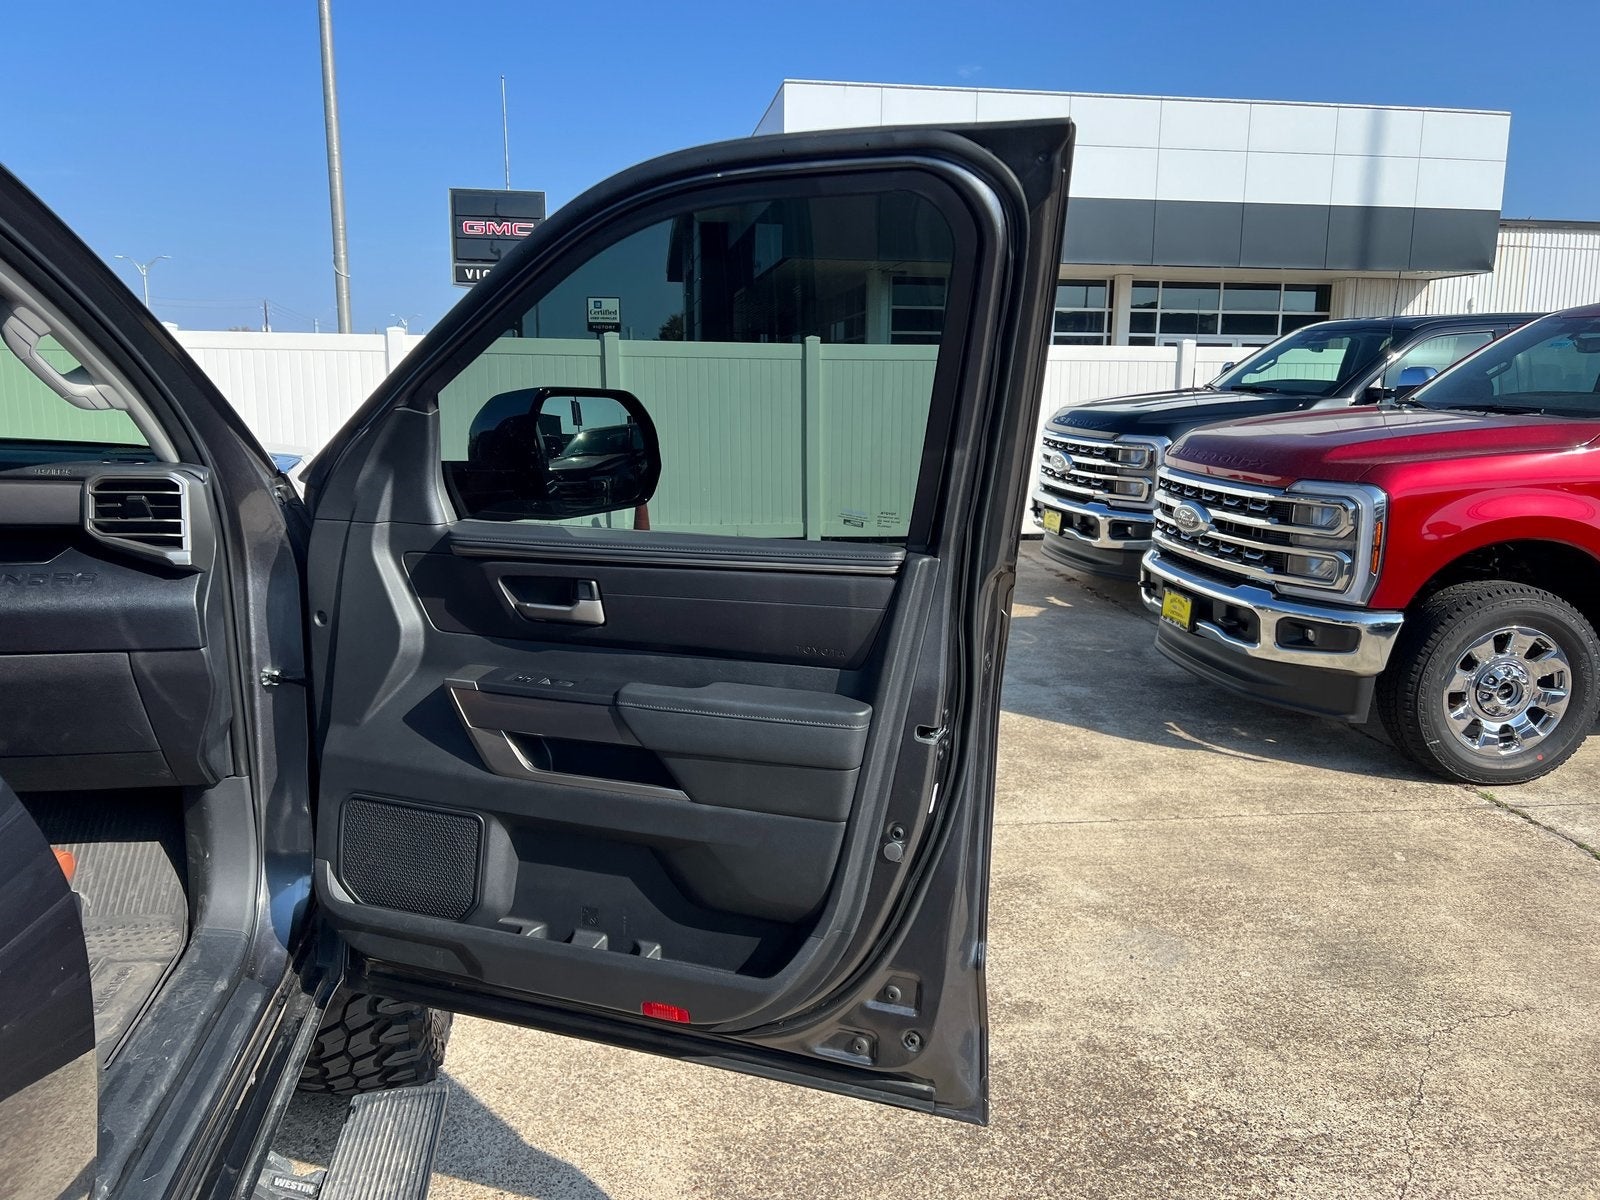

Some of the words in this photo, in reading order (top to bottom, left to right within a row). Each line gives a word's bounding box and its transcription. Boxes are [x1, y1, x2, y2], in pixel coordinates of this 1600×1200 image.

[463, 220, 534, 236] GMC
[1179, 510, 1195, 527] Ford
[793, 645, 847, 657] TOYOTA
[274, 1177, 316, 1195] WESTIN
